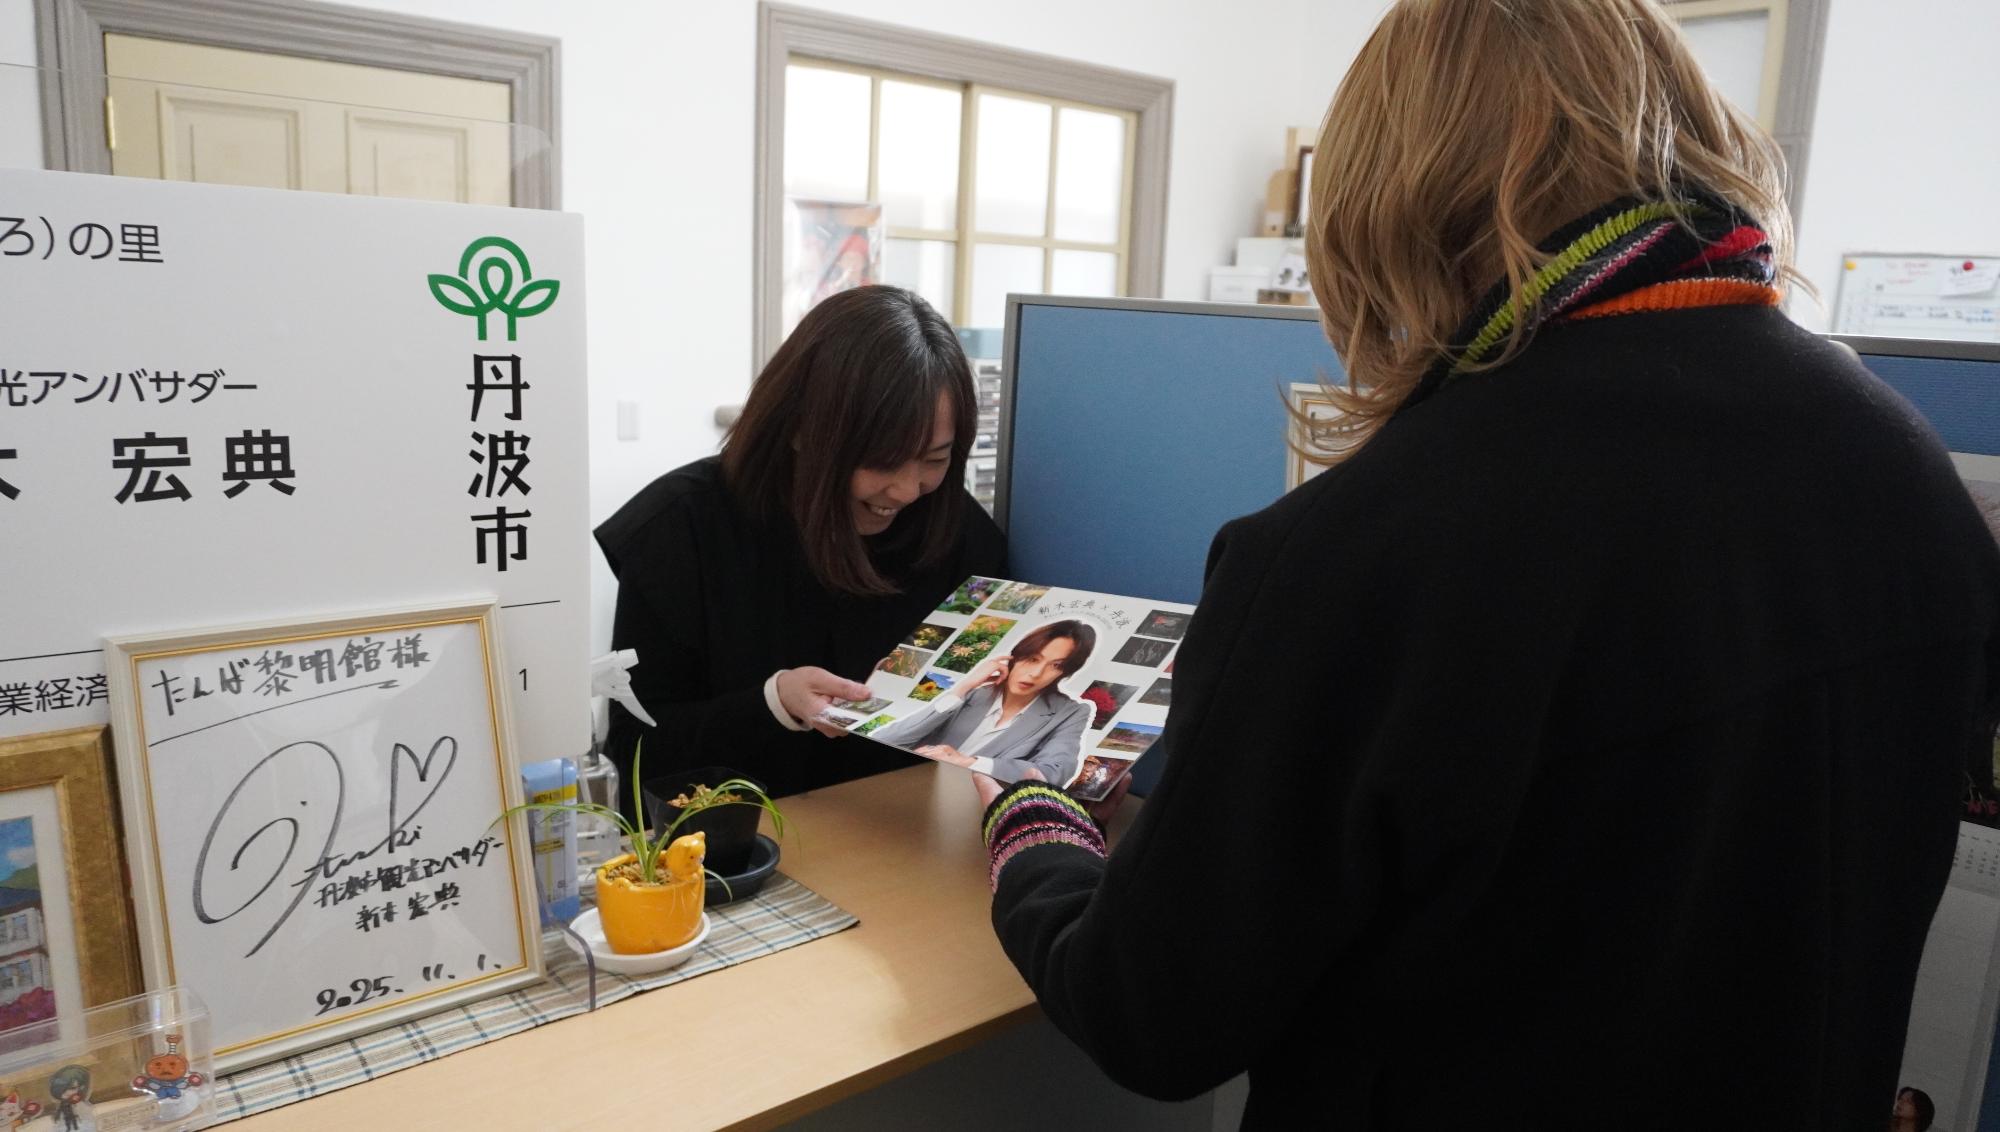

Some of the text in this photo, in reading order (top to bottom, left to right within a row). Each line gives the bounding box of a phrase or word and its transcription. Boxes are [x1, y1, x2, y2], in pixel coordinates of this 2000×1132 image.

[466, 353, 532, 572] 丹波市
[519, 668, 527, 691] 1
